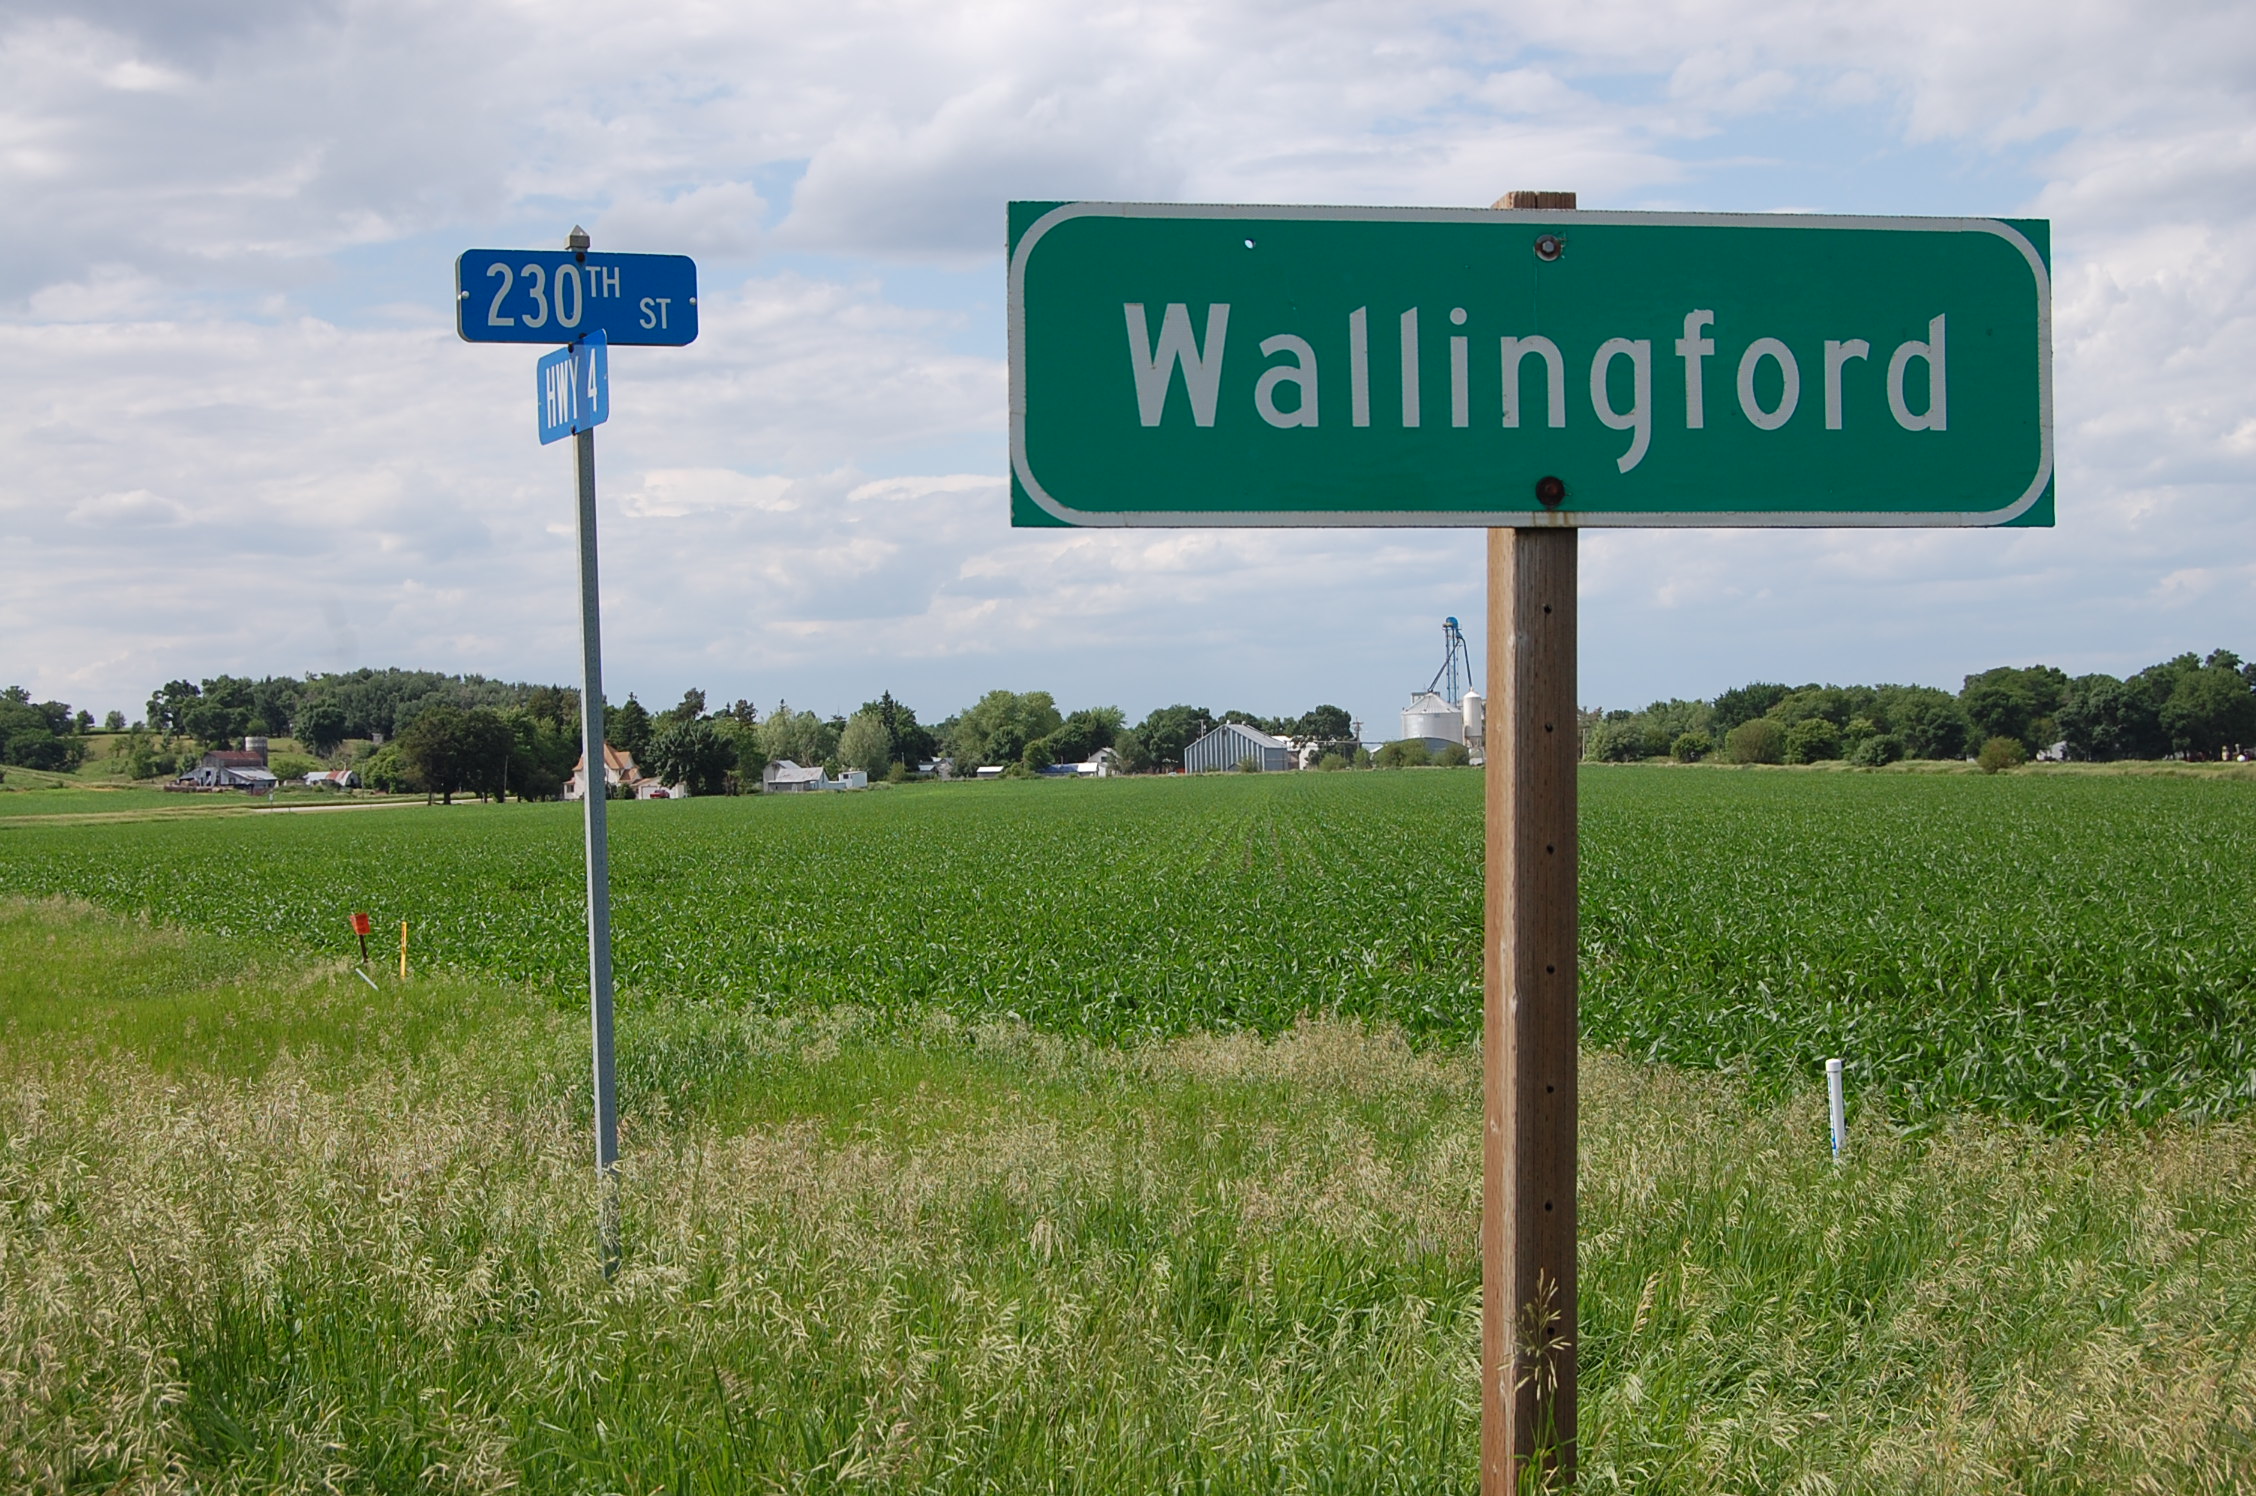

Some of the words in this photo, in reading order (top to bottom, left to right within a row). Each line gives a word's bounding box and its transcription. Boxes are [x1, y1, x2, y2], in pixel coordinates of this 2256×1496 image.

[486, 262, 621, 328] 230TH
[639, 297, 671, 329] ST
[546, 356, 578, 428] HWY
[587, 348, 598, 412] 4
[1123, 302, 1948, 475] Wallingford
